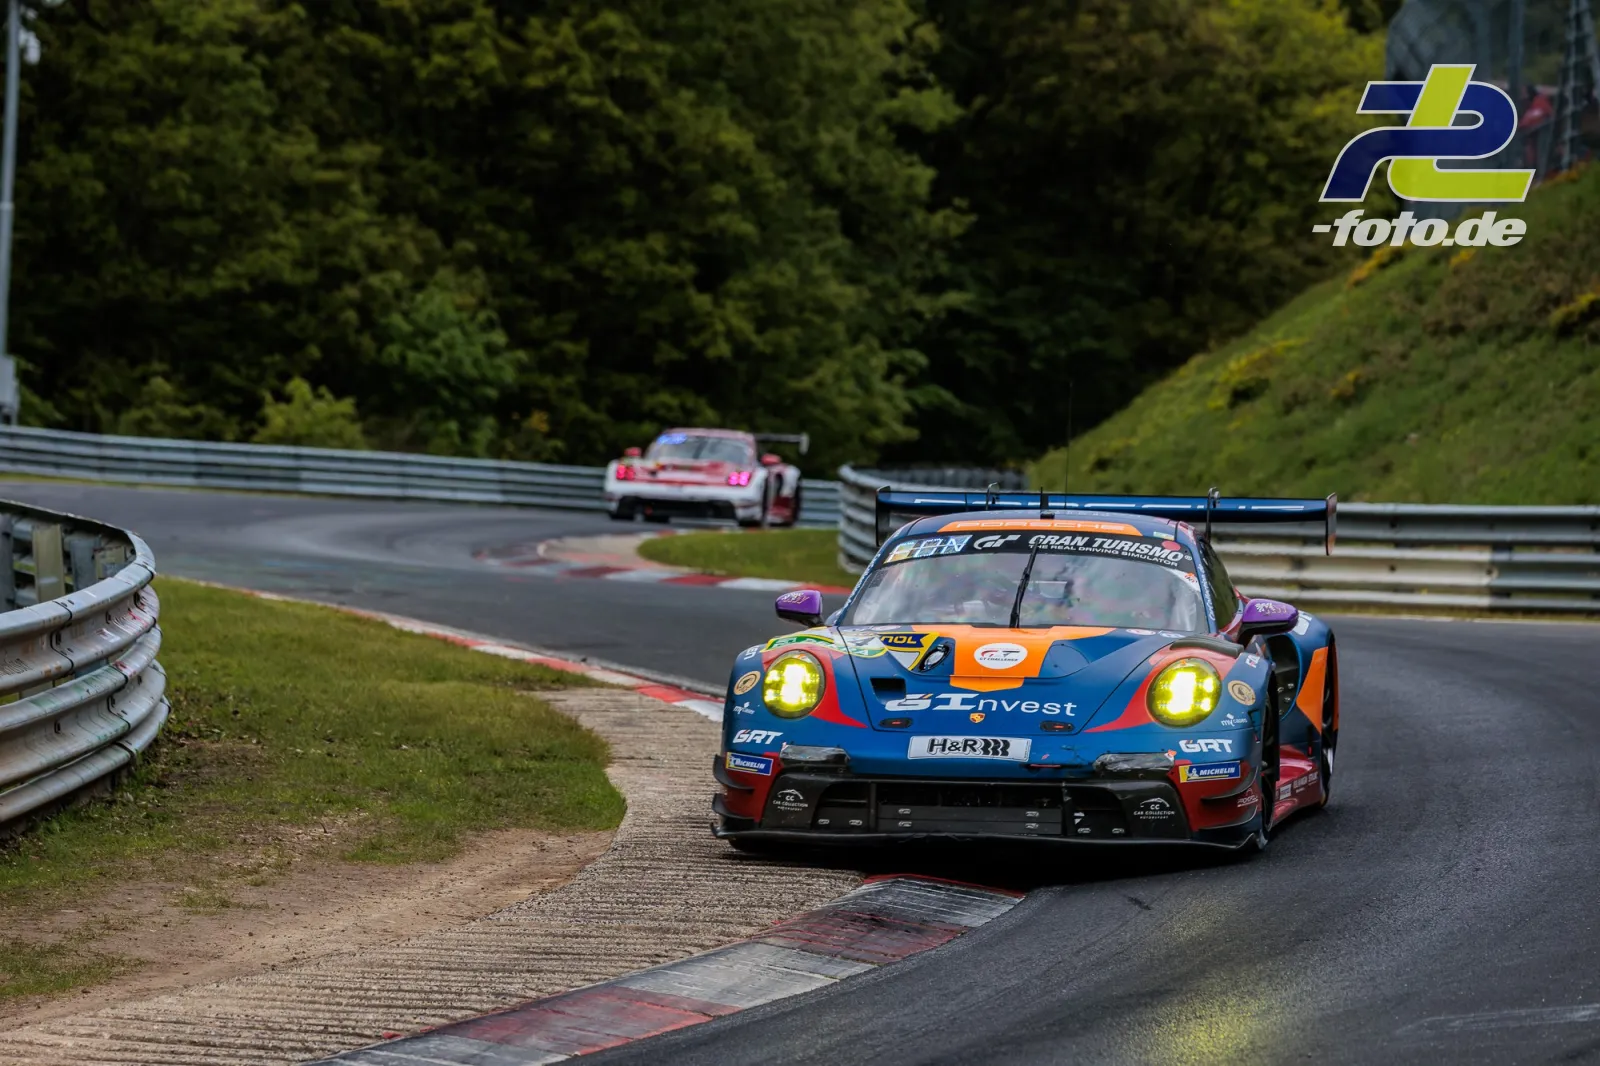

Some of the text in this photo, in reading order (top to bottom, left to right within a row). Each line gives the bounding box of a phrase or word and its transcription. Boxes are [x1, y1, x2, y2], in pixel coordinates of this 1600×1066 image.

[956, 519, 1126, 531] PORSCHE
[1028, 534, 1184, 562] GRAN TURISMO
[1078, 545, 1120, 555] DRIVING
[1122, 552, 1179, 567] SIMULATOR
[733, 729, 783, 745] GRT
[1178, 739, 1233, 753] GRT
[735, 759, 766, 770] MICHELIN
[1200, 767, 1236, 777] MICHELIN
